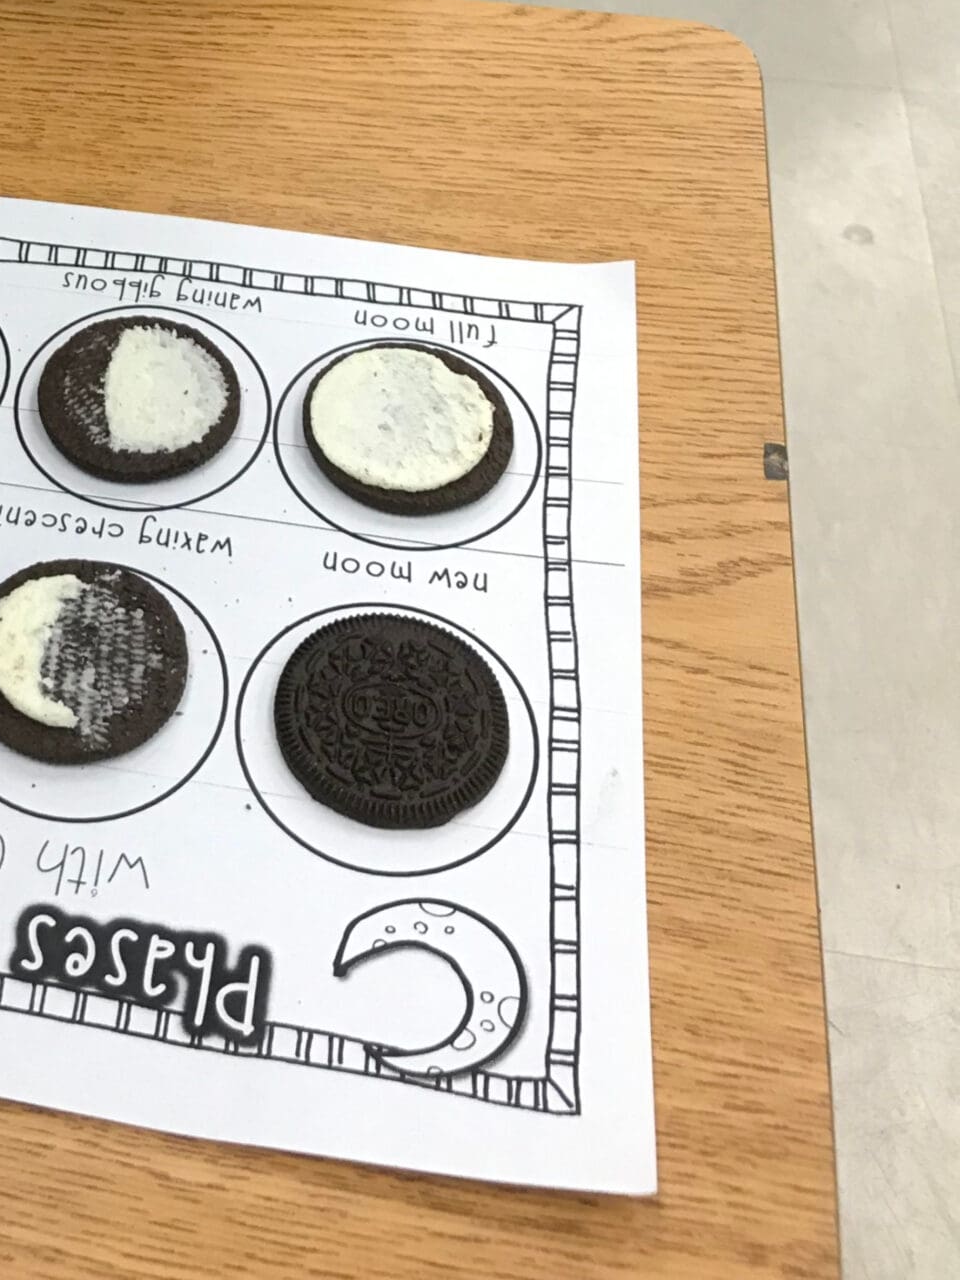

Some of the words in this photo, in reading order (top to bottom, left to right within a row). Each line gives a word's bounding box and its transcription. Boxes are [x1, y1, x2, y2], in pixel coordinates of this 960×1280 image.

[62, 271, 161, 303] gibbous
[176, 276, 263, 314] waning
[353, 309, 435, 336] moon
[449, 319, 497, 349] full
[138, 514, 234, 558] waxing
[321, 550, 414, 583] moon
[428, 566, 489, 594] new
[351, 693, 429, 728] OREO
[36, 838, 150, 898] with
[18, 913, 262, 1036] Phases
